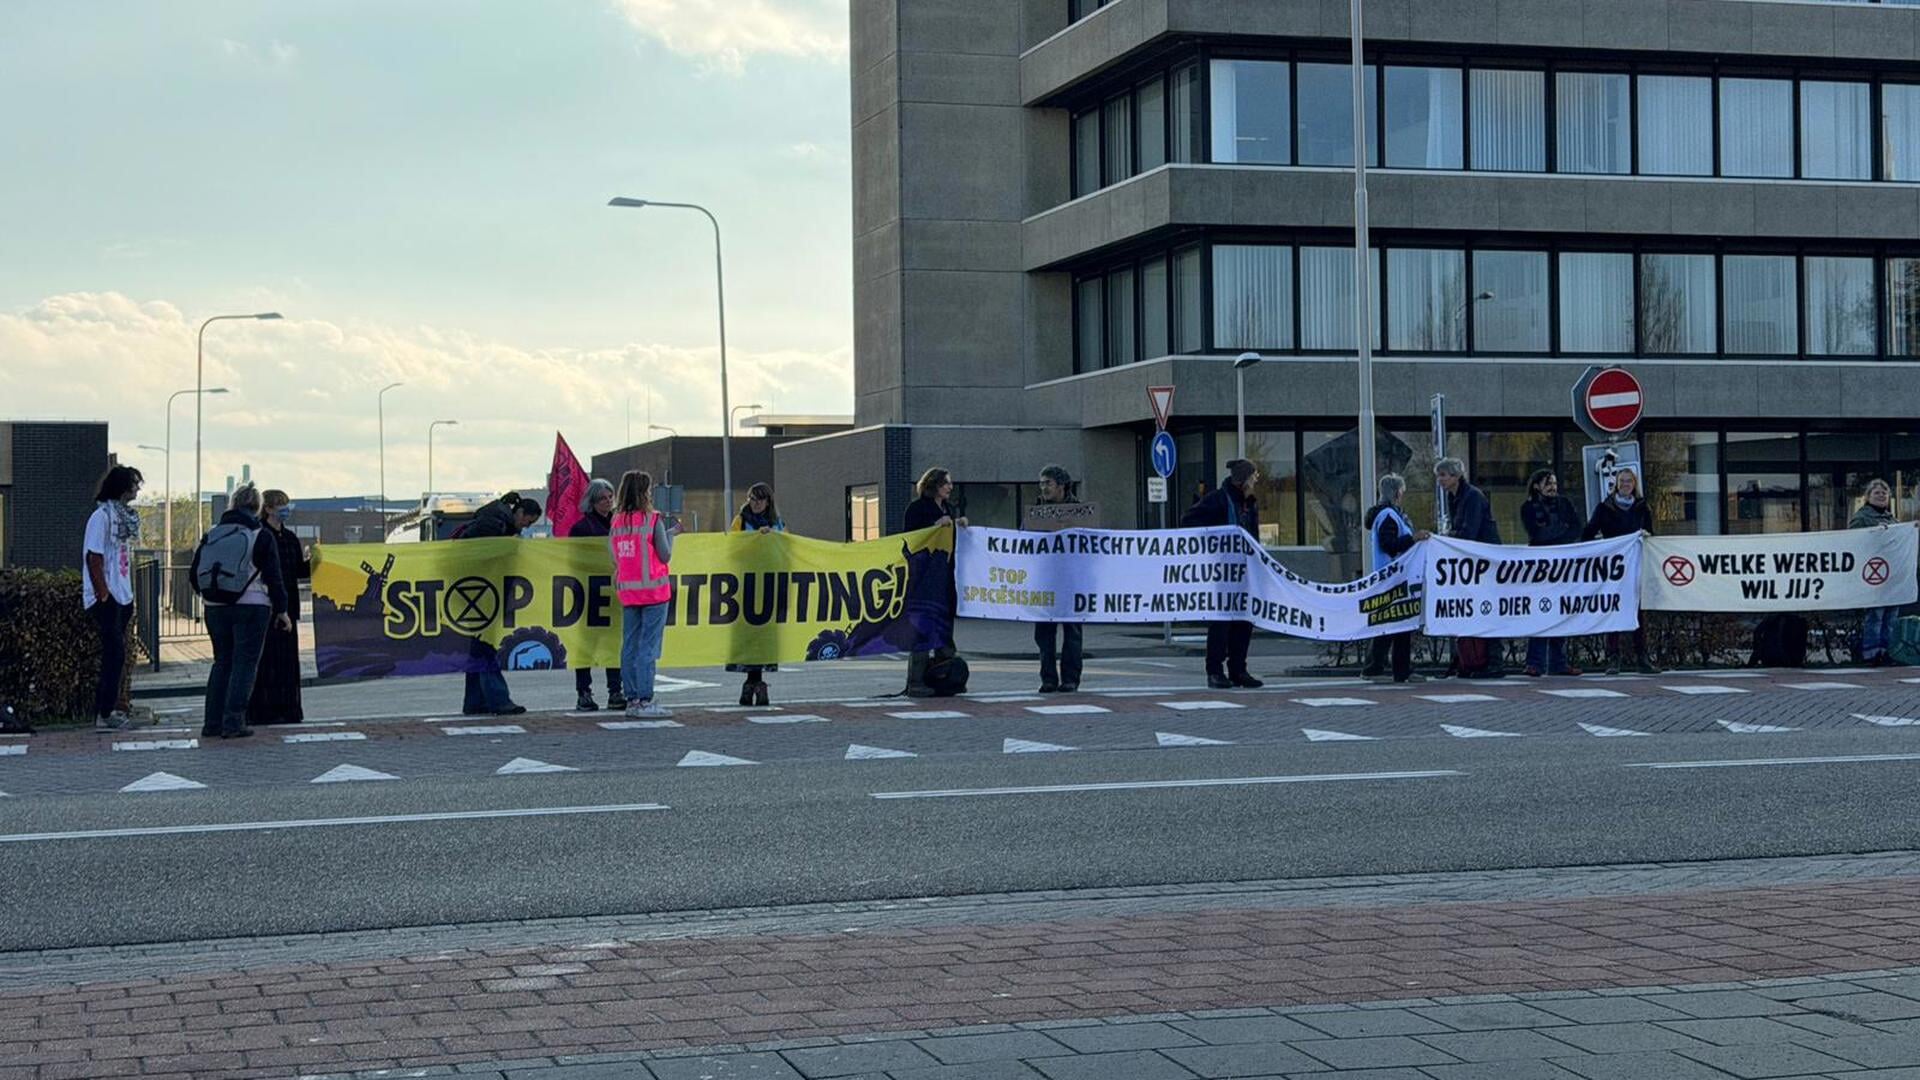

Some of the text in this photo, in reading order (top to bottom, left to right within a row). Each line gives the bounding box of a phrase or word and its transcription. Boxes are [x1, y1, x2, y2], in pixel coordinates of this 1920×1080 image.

[989, 567, 1027, 584] STOP
[1163, 563, 1247, 584] INCLUSIEF
[1435, 554, 1625, 586] STOP UITBUITING
[1698, 552, 1855, 575] WELKE WERELD
[1363, 586, 1404, 611] ANIMAL
[1741, 578, 1824, 599] WIL JIJ?
[386, 566, 907, 636] STOP DE ITBUITING!
[1074, 593, 1097, 613] DE
[1104, 592, 1249, 613] NIET-MENSELIJKE
[1252, 597, 1312, 630] DIEREN
[1371, 601, 1421, 624] REBELLIO
[1435, 593, 1620, 618] MENS DIER NATUUR
